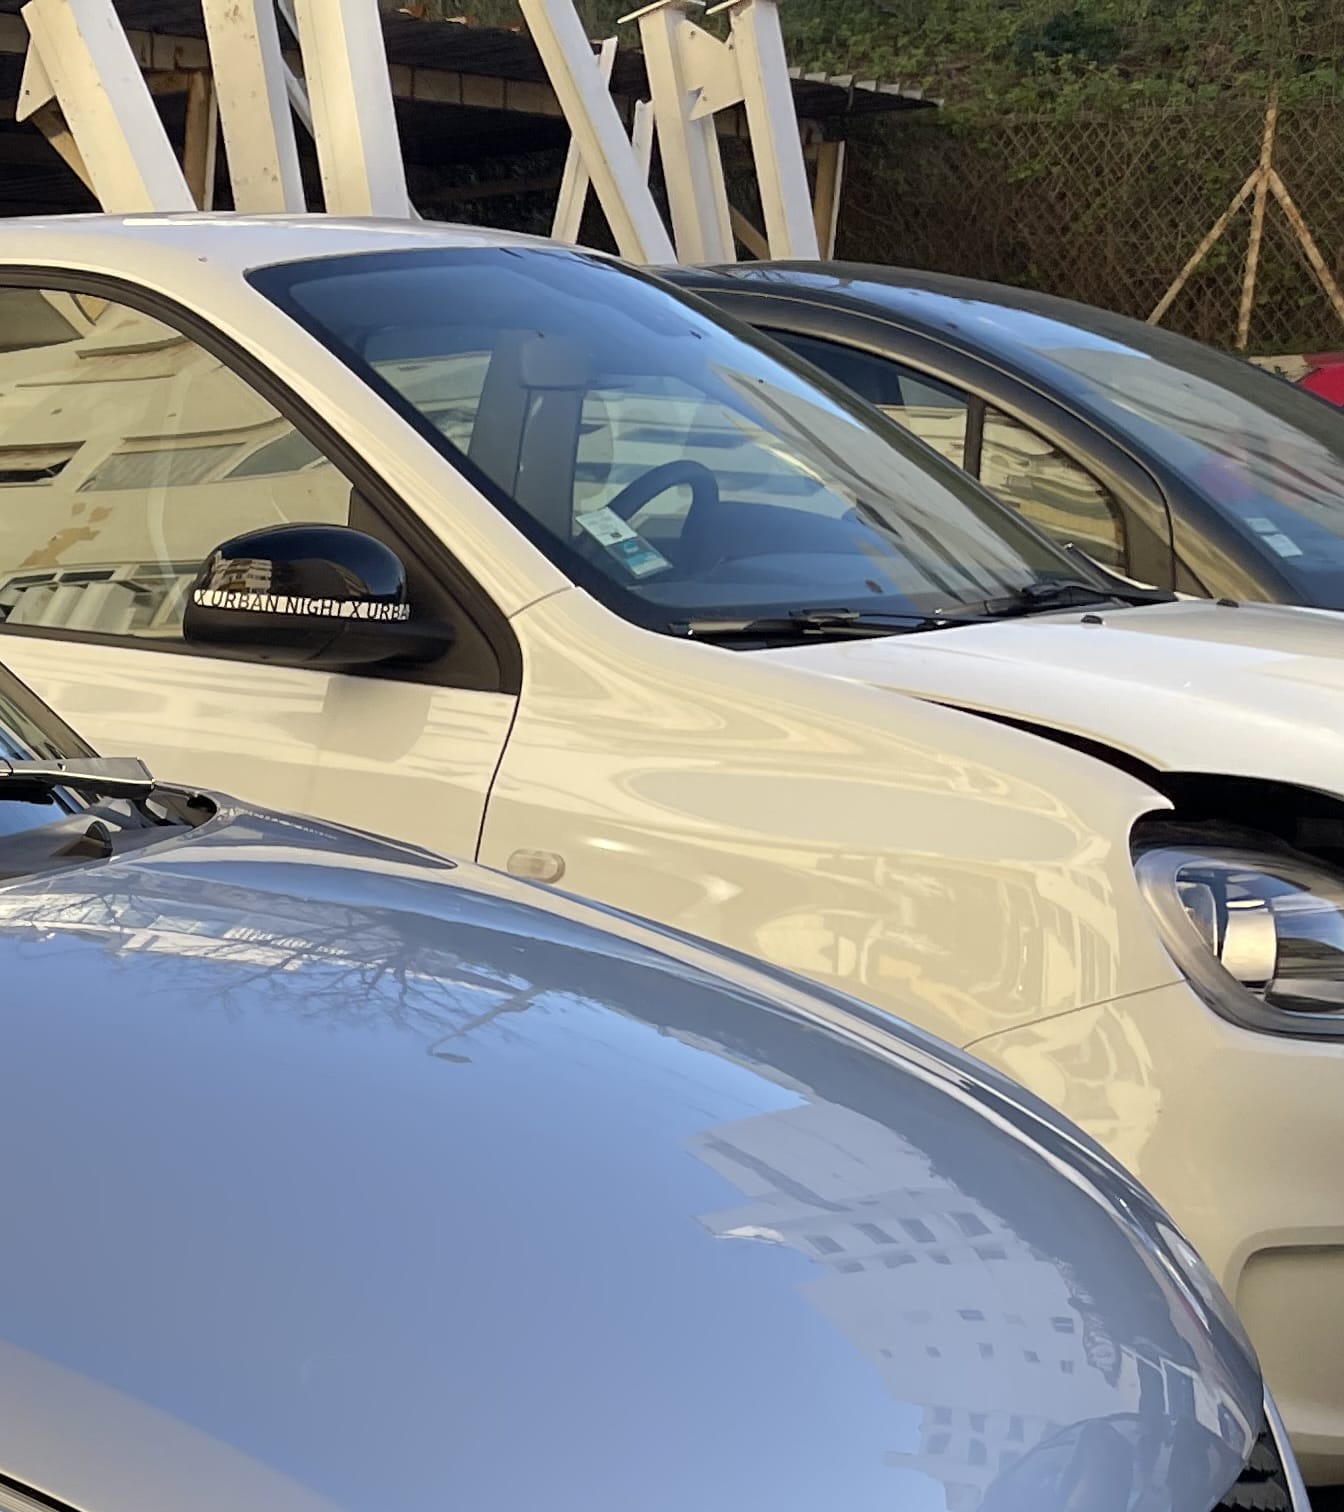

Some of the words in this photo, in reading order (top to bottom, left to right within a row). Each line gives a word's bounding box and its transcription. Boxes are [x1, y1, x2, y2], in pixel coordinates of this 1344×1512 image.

[211, 591, 278, 612] URBAN
[285, 596, 344, 617] NIGHT
[349, 600, 361, 619] X
